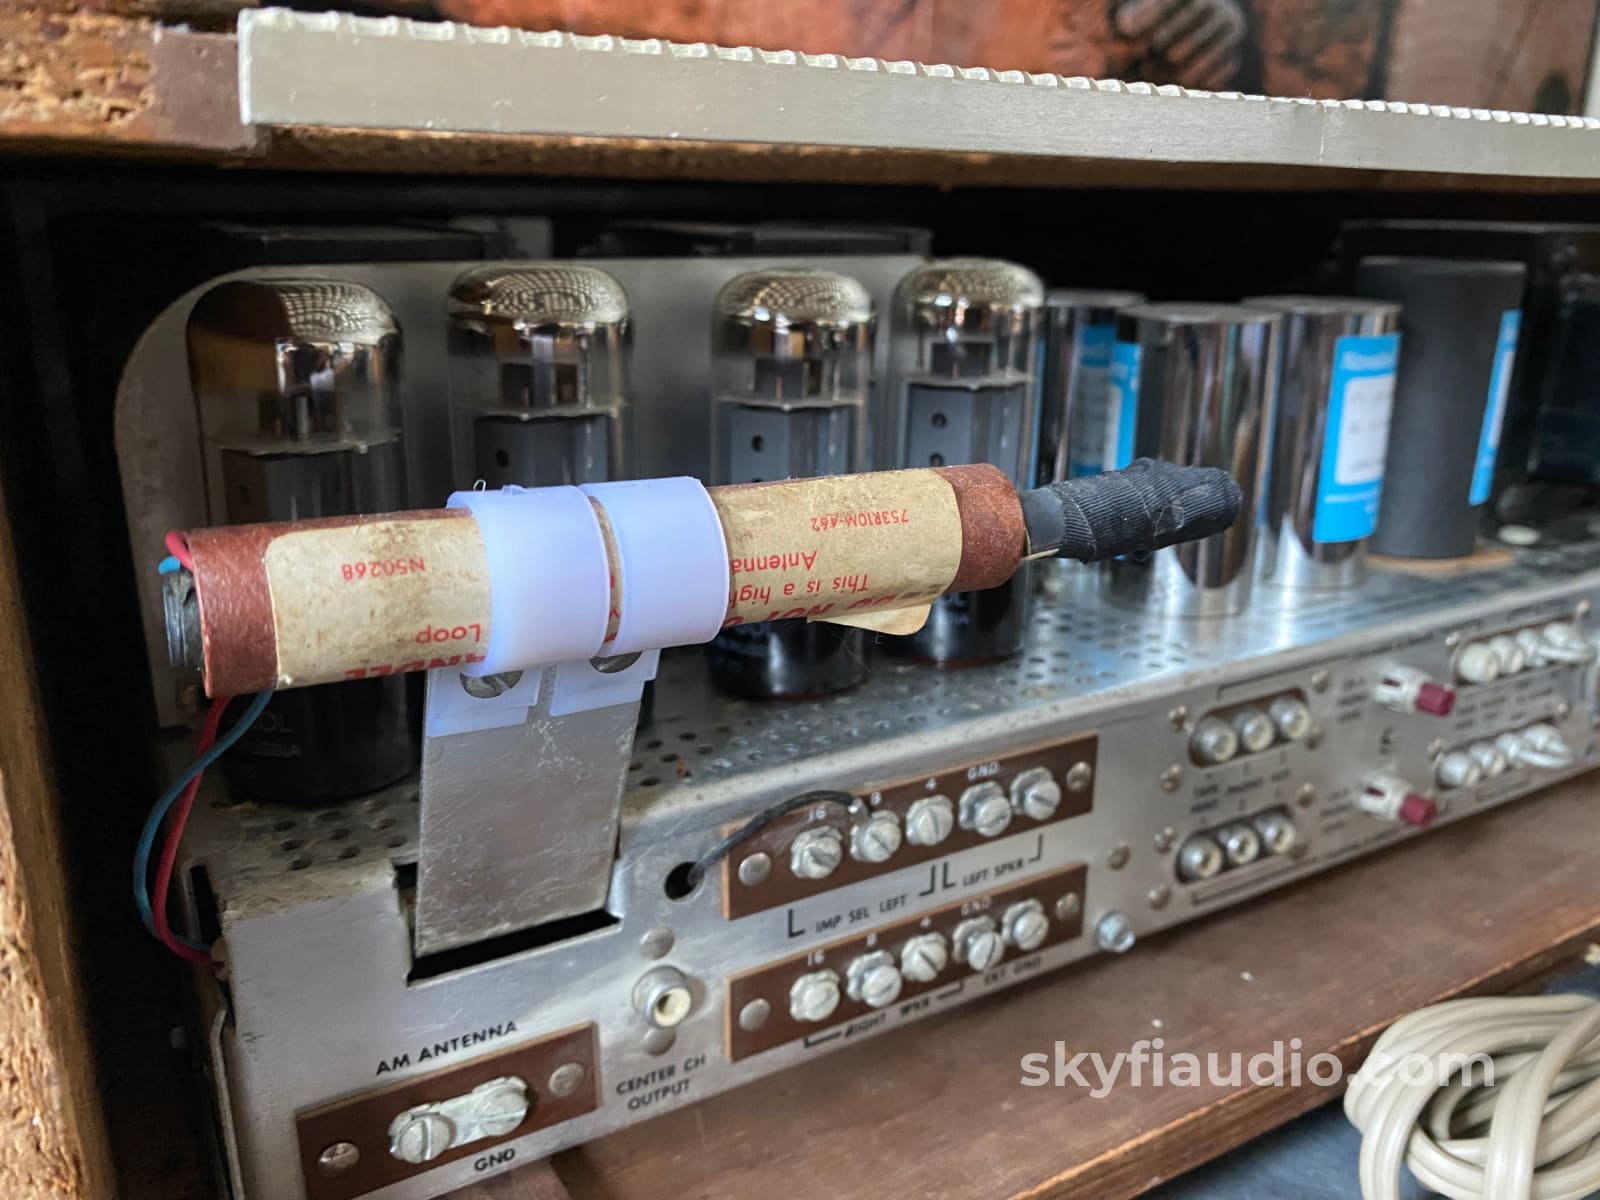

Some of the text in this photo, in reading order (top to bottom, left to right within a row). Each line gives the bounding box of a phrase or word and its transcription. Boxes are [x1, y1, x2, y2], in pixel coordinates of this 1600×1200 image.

[731, 550, 818, 574] Antenna
[783, 583, 795, 596] a
[805, 579, 821, 597] is
[832, 574, 870, 594] This
[415, 623, 482, 644] Loop
[962, 868, 990, 887] LEFT
[848, 906, 871, 923] SEL
[879, 894, 908, 914] LEFT
[376, 1021, 518, 1076] AM ANTENNA
[616, 1063, 676, 1095] CENTER
[628, 1077, 691, 1111] OUTPUT
